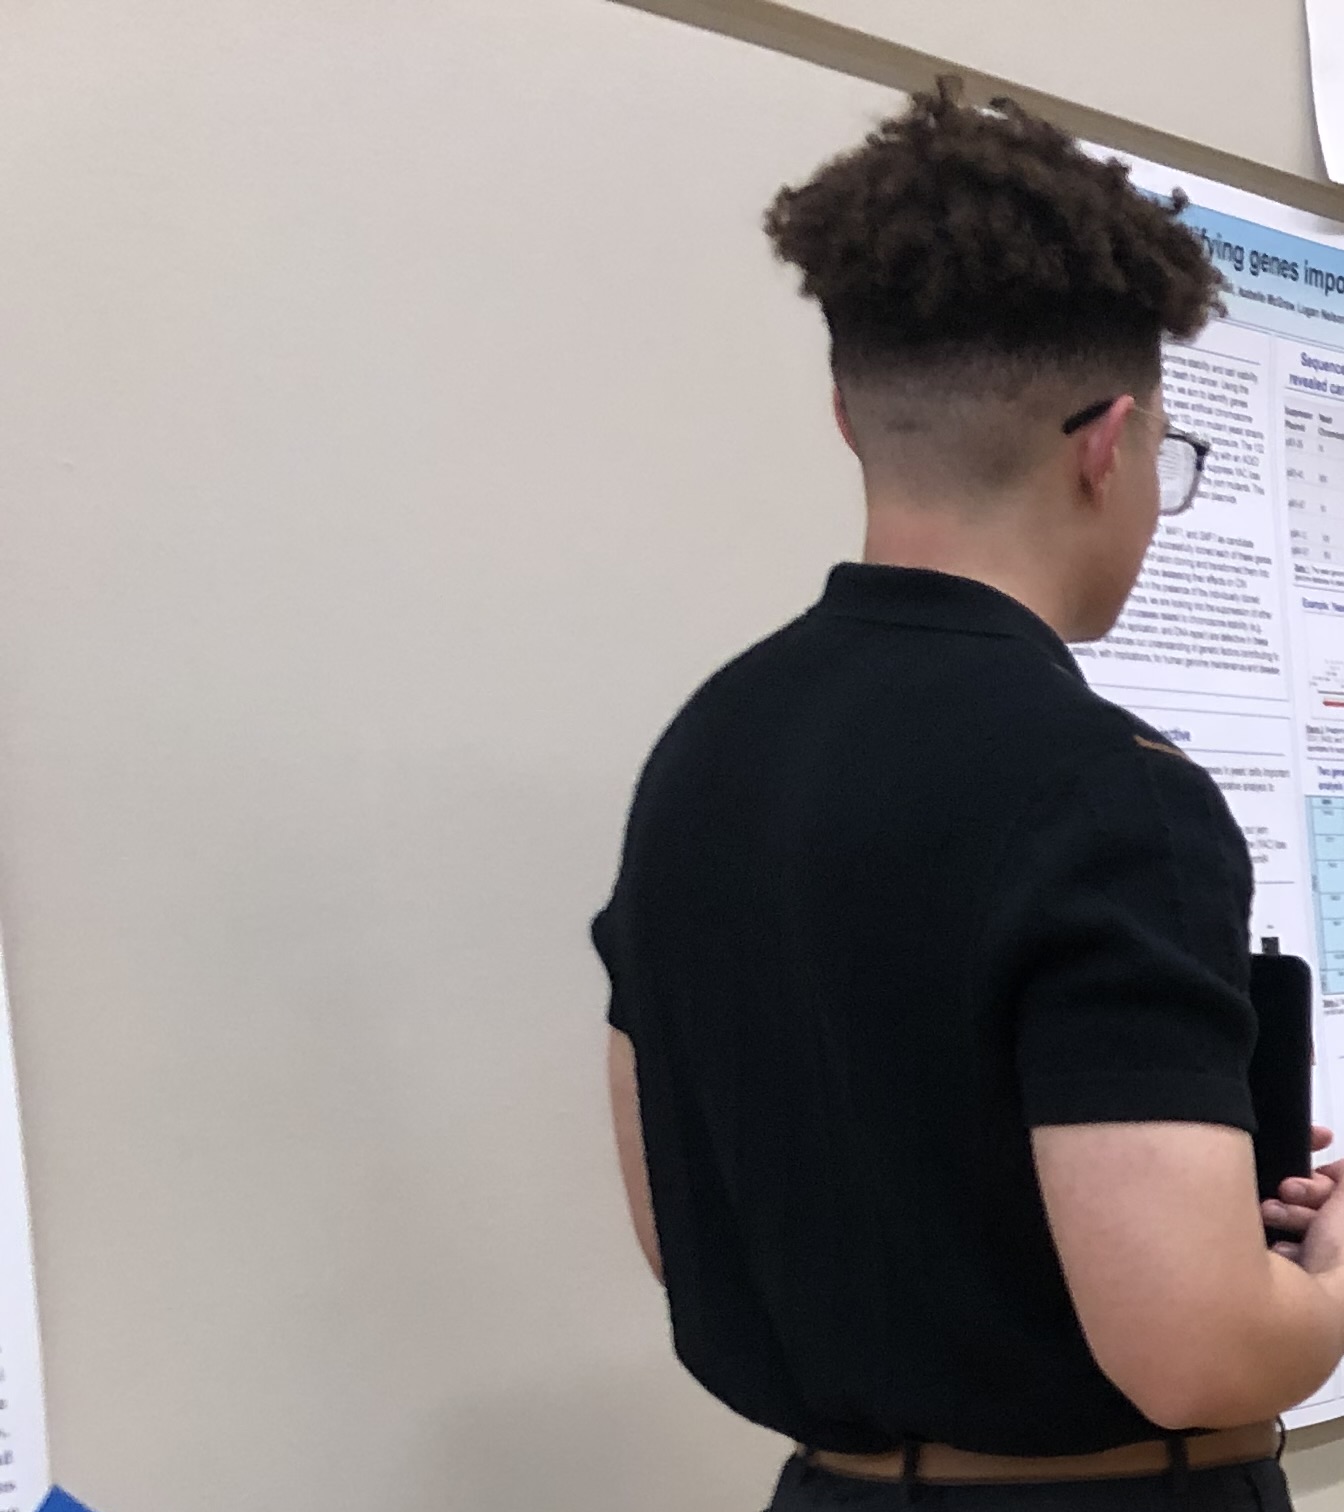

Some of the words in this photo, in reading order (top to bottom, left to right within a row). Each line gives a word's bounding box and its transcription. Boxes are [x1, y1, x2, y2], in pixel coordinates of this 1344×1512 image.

[1199, 228, 1244, 272] fying
[1250, 249, 1299, 282] genes
[1301, 352, 1344, 375] Sequence
[1289, 374, 1327, 392] revealed
